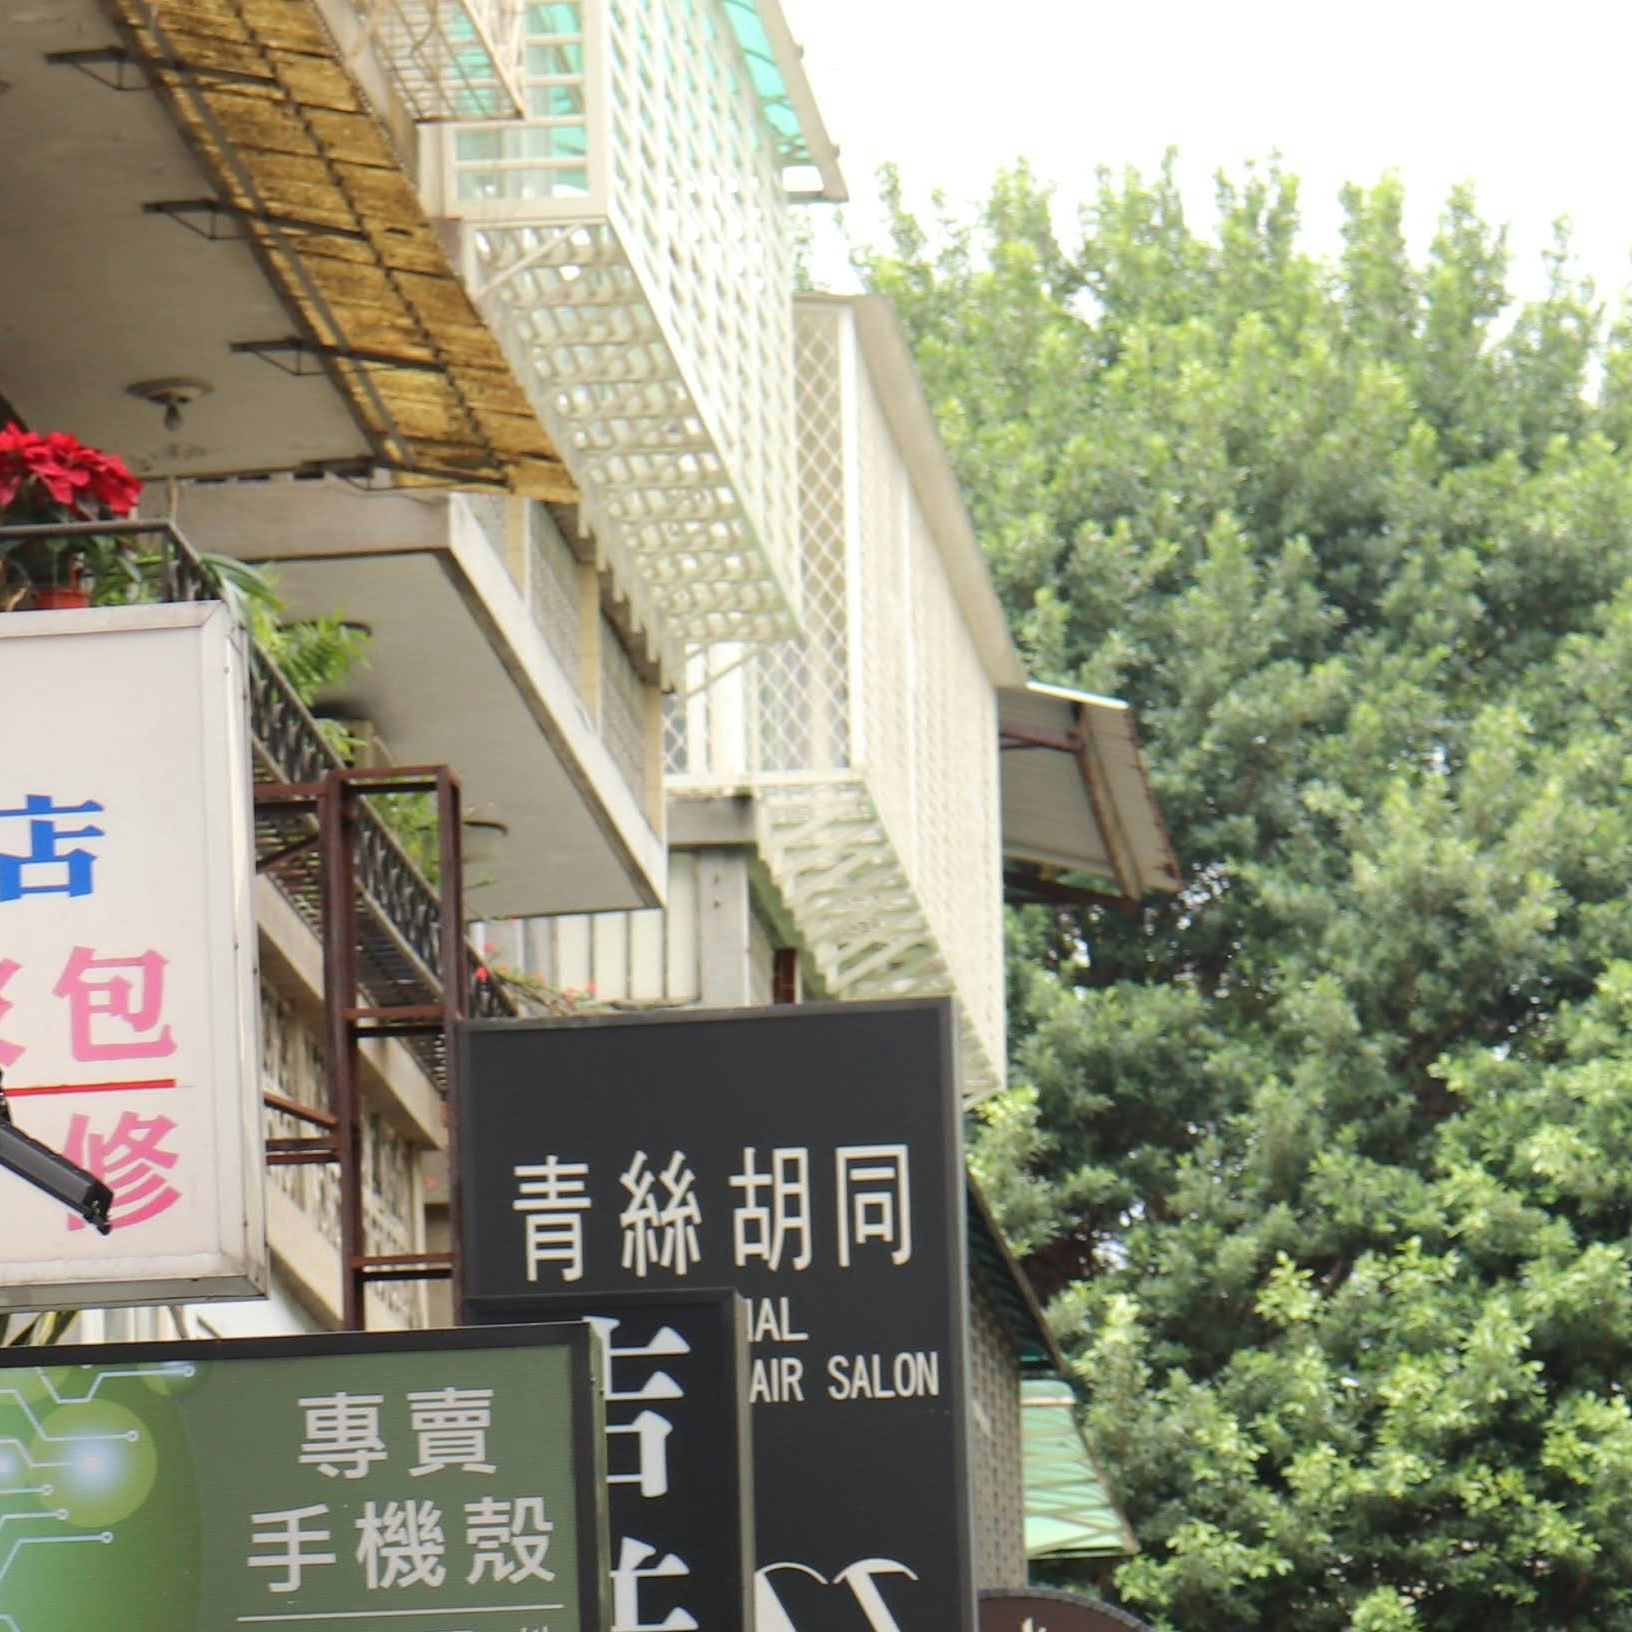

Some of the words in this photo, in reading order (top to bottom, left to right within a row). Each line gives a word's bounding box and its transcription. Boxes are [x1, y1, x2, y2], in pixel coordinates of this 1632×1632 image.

[513, 1142, 913, 1283] 青絲胡同
[828, 1352, 940, 1400] SALON
[298, 1387, 497, 1480] 專賣
[247, 1497, 556, 1593] 手機殼
